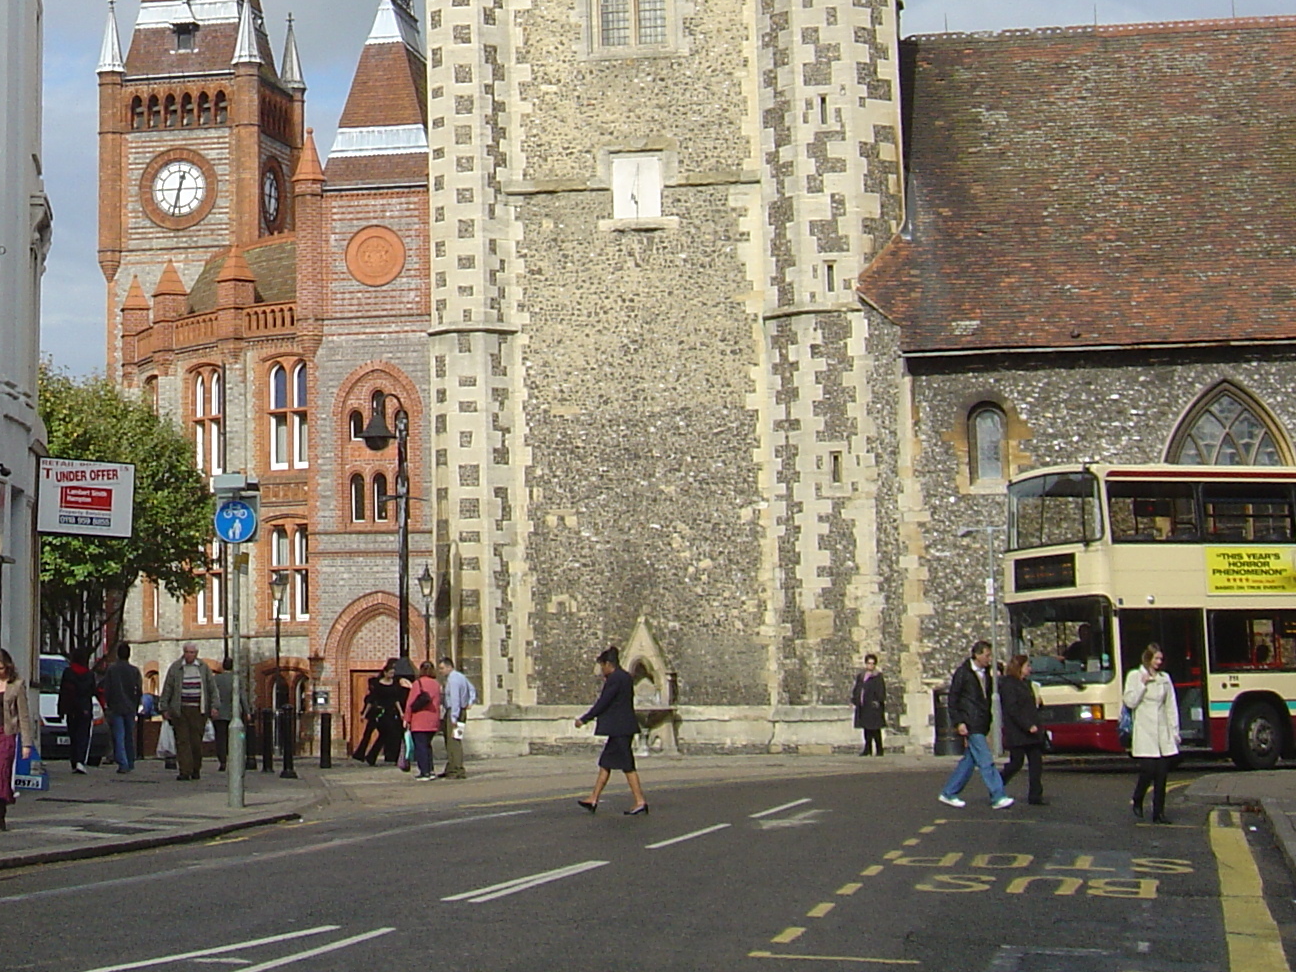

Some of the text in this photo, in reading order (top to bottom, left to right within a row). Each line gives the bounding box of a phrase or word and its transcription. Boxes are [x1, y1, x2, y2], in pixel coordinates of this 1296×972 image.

[55, 469, 119, 483] UNDER OFFER
[892, 852, 1195, 874] STOP
[915, 874, 1160, 899] BUS
